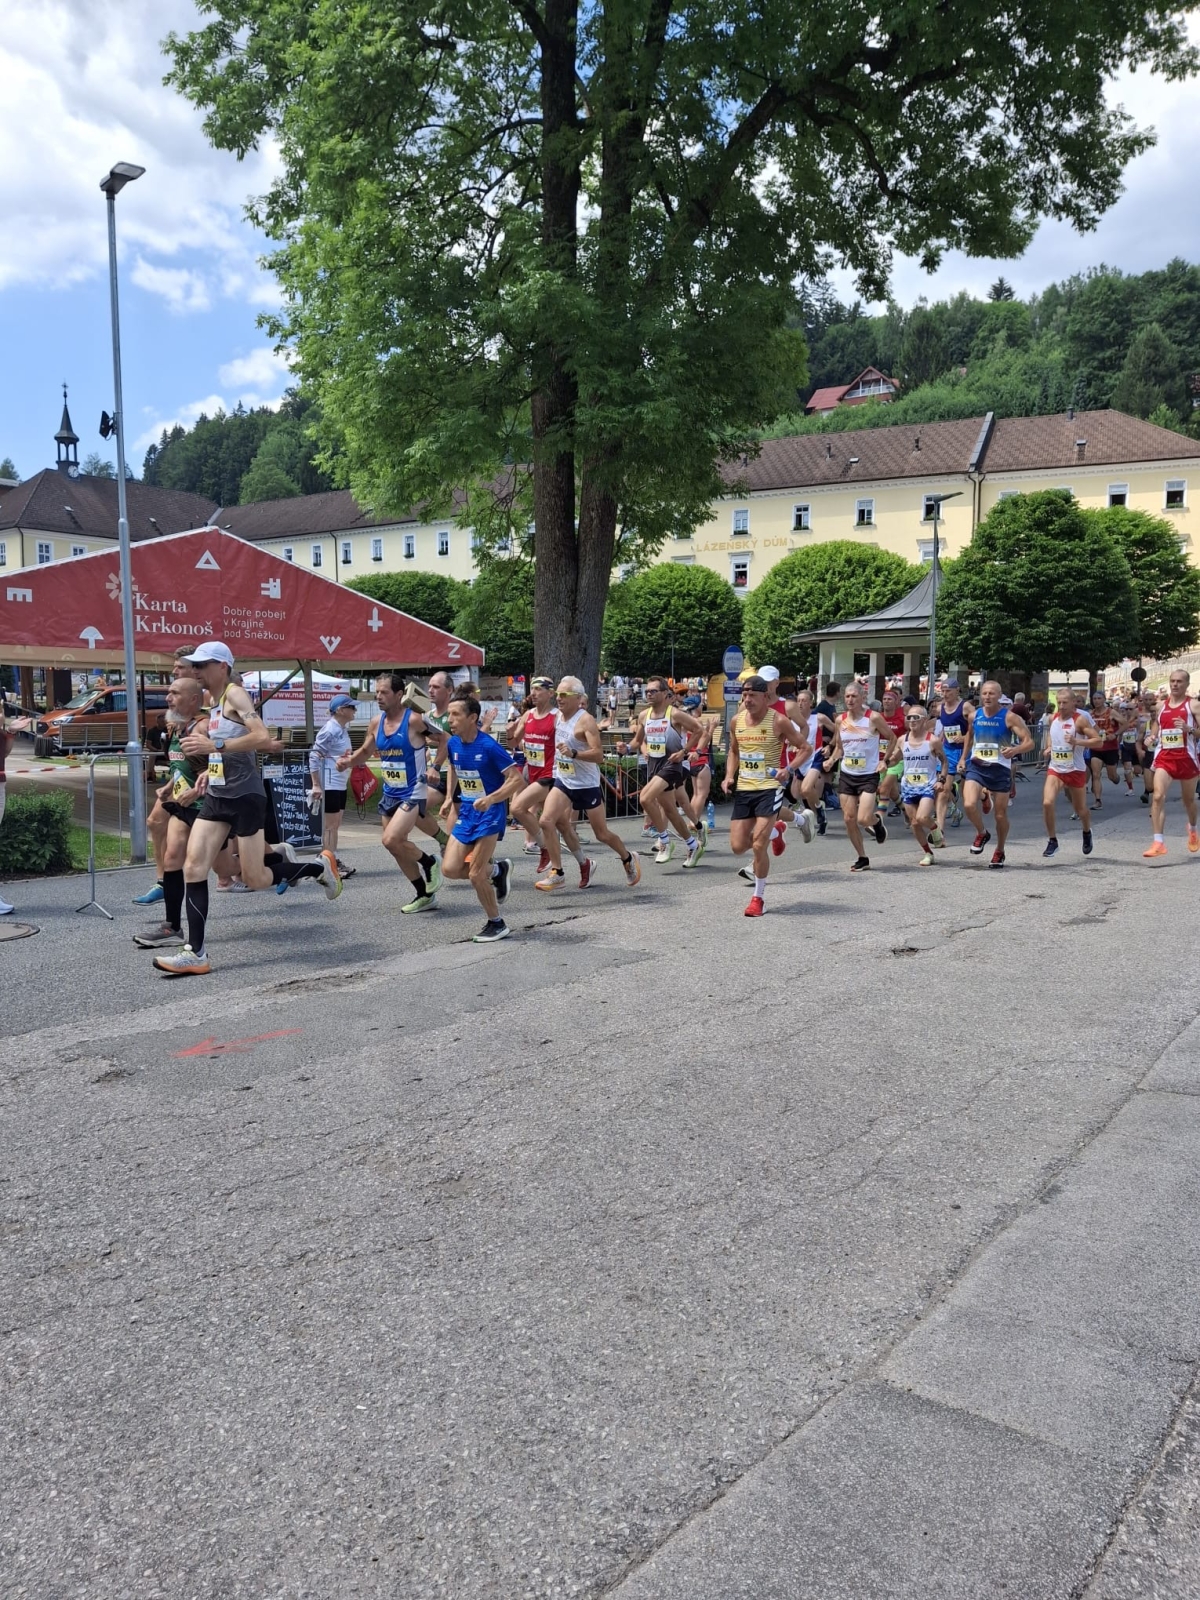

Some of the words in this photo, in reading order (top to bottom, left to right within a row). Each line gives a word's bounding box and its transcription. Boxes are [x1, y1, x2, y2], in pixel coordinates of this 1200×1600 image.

[134, 592, 188, 614] Karta
[223, 605, 252, 616] Dobře
[255, 609, 286, 619] pobejt
[134, 614, 214, 636] Krkonoš
[223, 619, 230, 627] v
[231, 618, 265, 630] Krajině
[224, 630, 241, 639] pod
[244, 629, 285, 640] Sněžkou
[744, 761, 759, 770] 236
[386, 770, 401, 779] 904
[462, 780, 477, 789] 392
